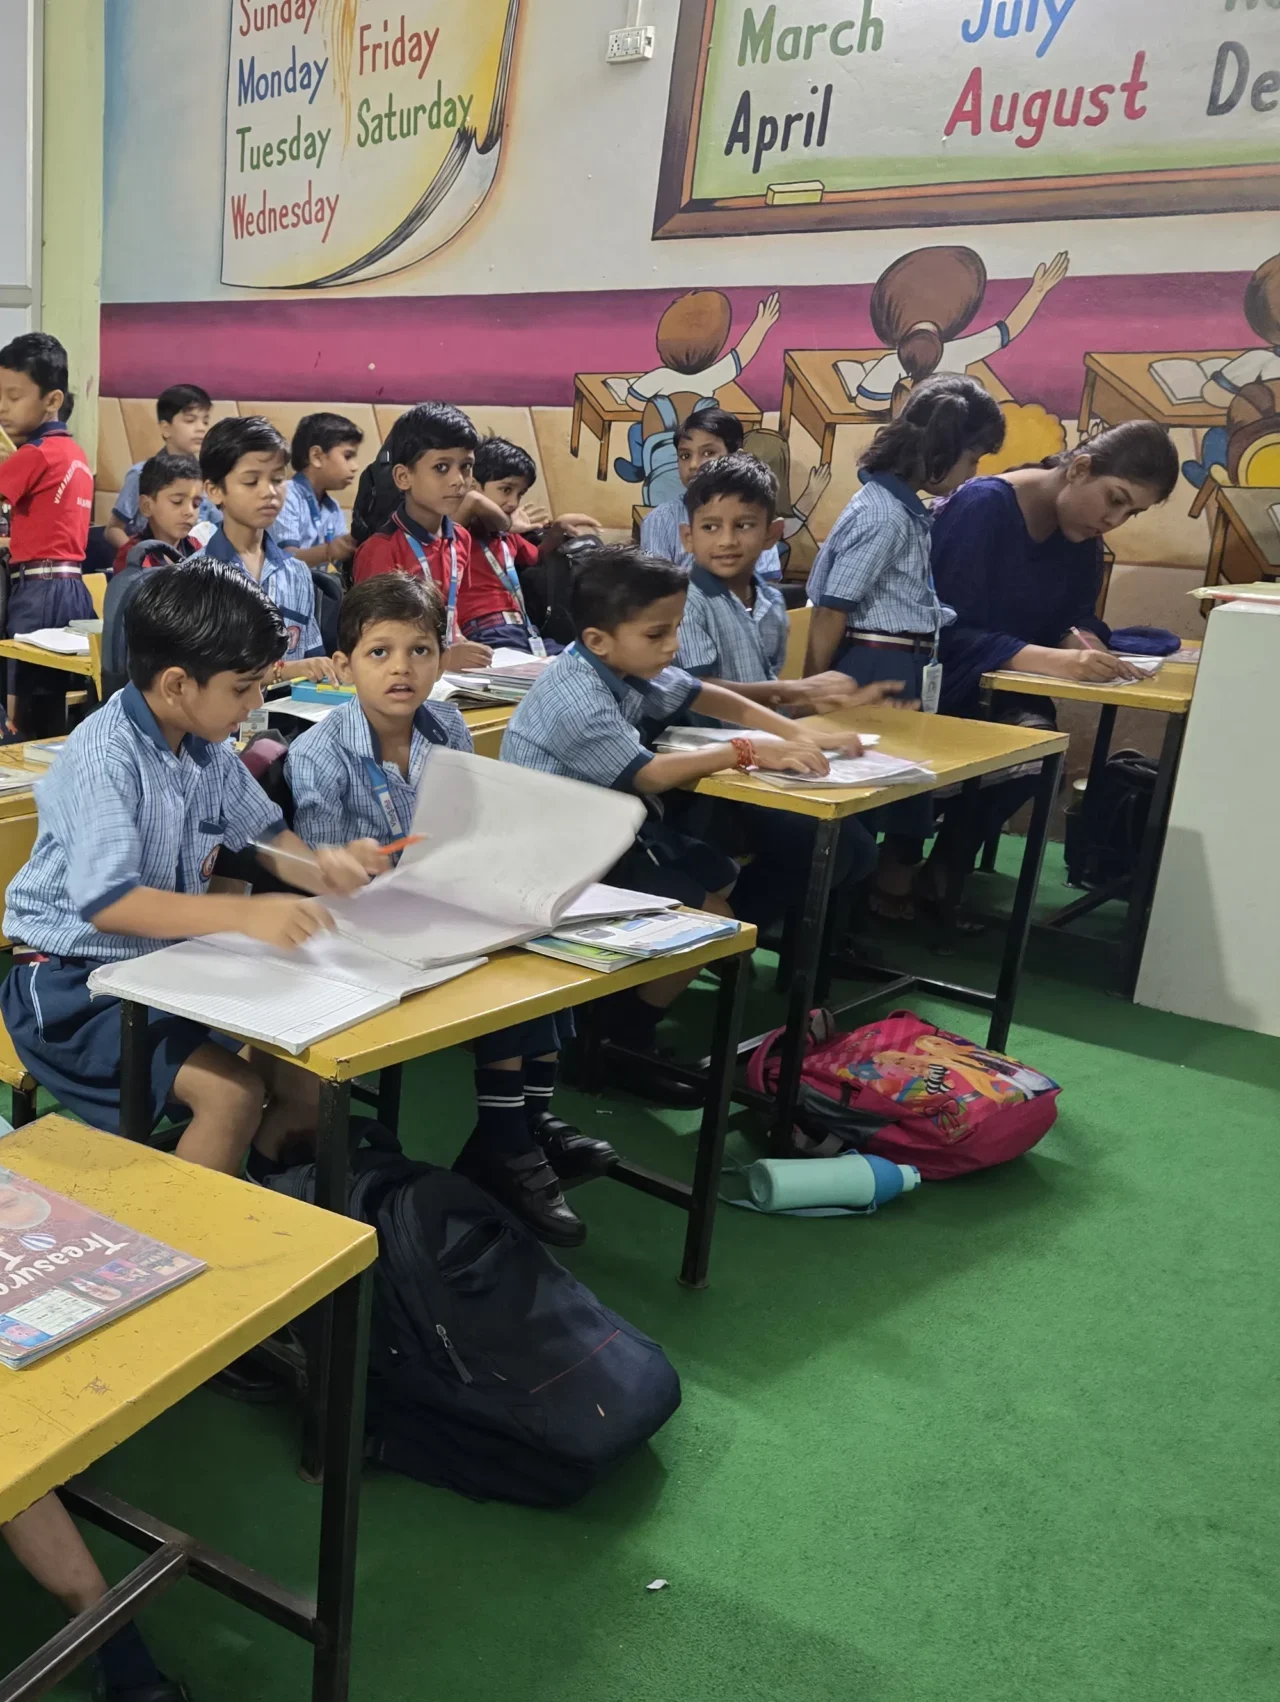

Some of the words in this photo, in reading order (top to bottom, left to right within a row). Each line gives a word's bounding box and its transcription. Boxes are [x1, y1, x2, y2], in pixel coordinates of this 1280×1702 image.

[359, 15, 440, 79] Friday
[737, 0, 884, 67] March
[237, 44, 328, 107] Monday
[943, 50, 1149, 148] August
[236, 115, 332, 173] Tuesday
[356, 79, 474, 149] Saturday
[723, 84, 833, 174] April
[231, 180, 339, 243] Wednesday
